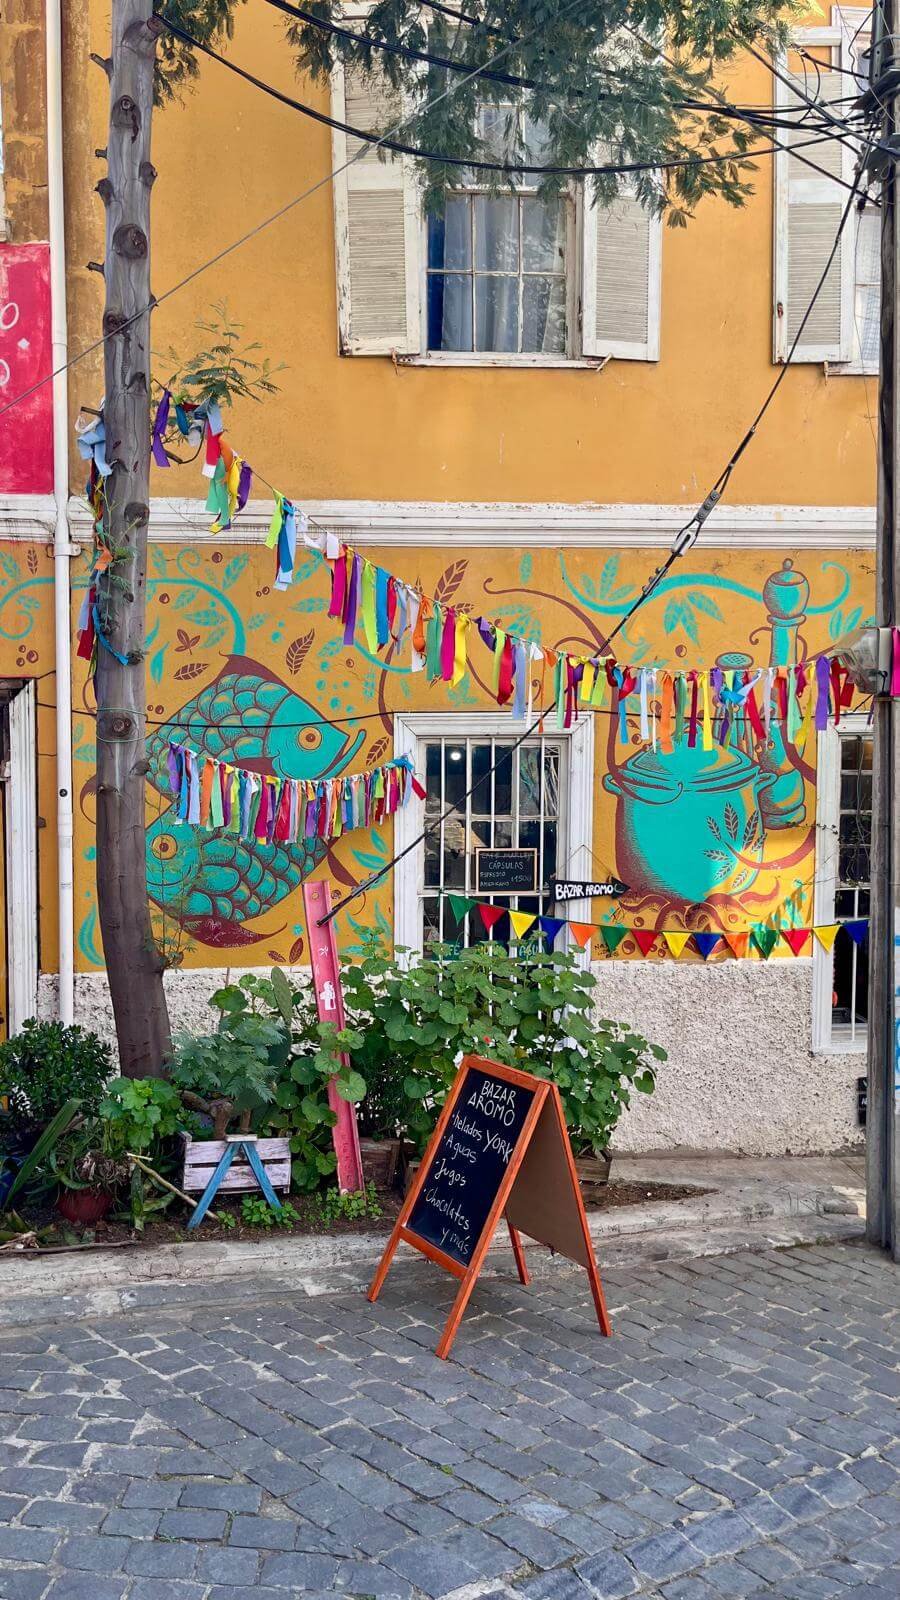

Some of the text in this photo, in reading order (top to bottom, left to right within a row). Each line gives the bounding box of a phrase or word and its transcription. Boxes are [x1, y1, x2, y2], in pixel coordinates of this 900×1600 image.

[489, 860, 523, 870] CÁPSULAS
[555, 883, 614, 900] BAZAR AROMO
[467, 1092, 516, 1126] AROMO
[481, 1080, 516, 1109] BAZAR
[445, 1134, 477, 1163] Aguas
[453, 1110, 513, 1164] helados YORK
[434, 1158, 467, 1186] Jugos
[425, 1187, 470, 1230] Chocolates
[449, 1235, 471, 1255] más
